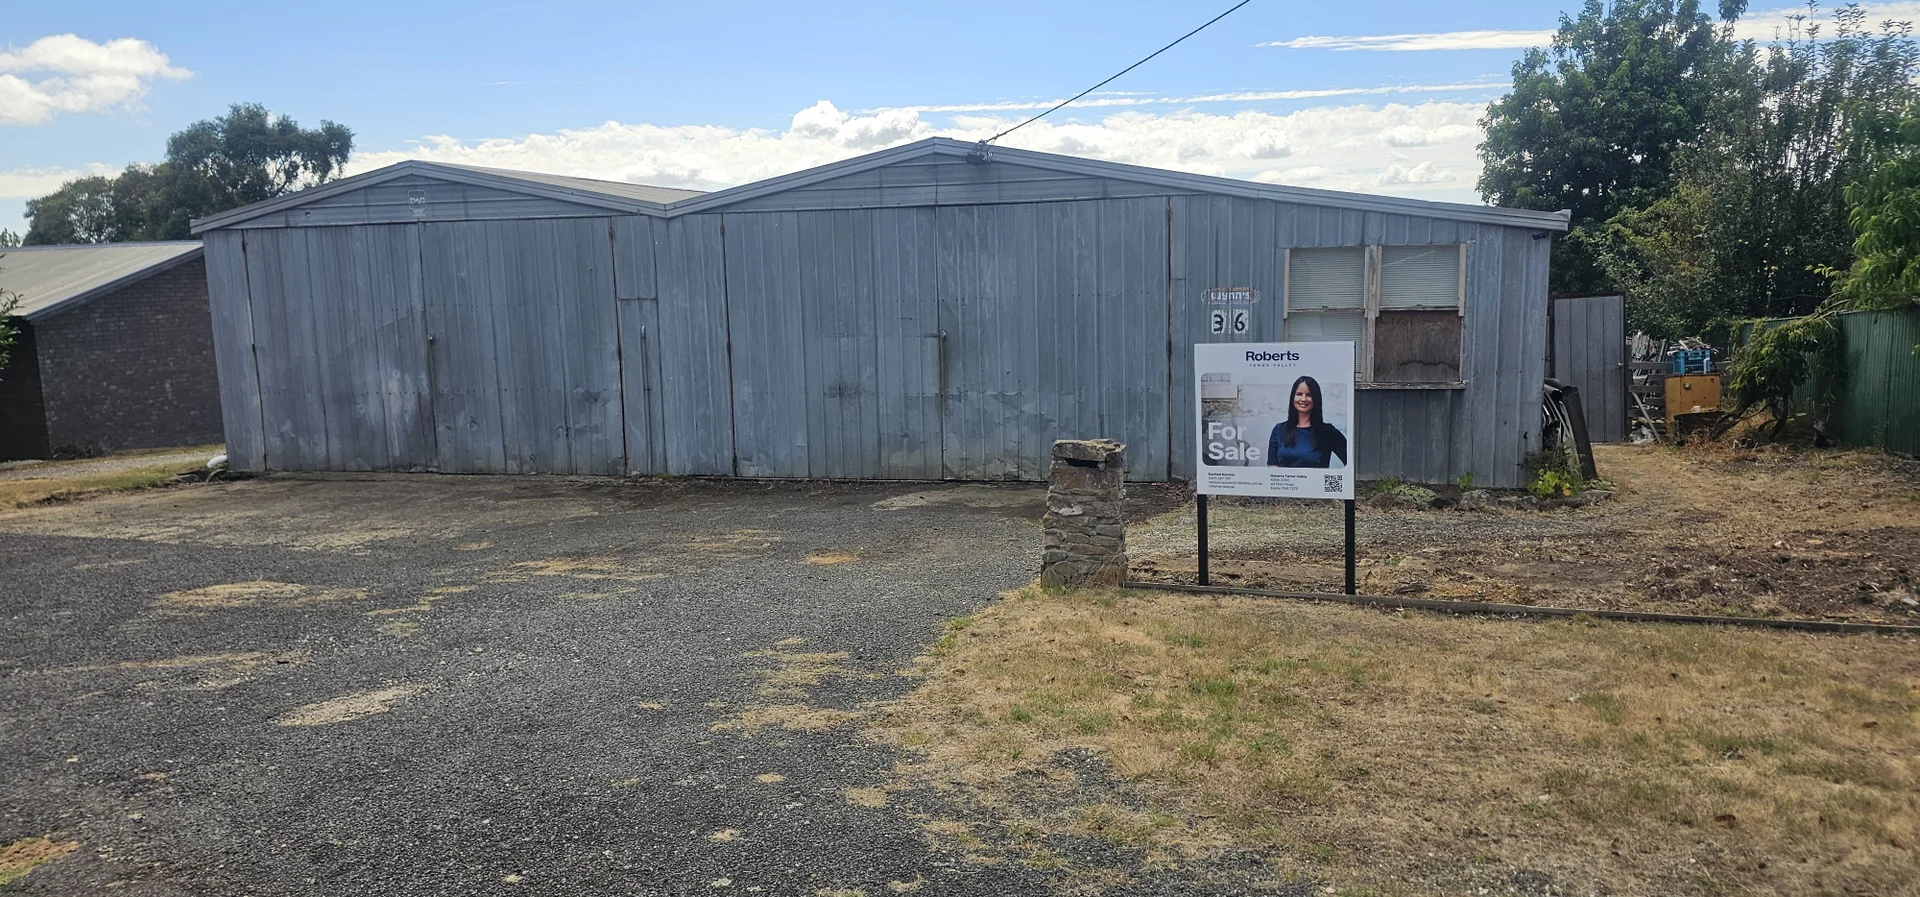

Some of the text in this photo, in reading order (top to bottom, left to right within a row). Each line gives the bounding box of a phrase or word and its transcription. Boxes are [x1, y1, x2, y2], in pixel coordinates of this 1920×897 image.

[1213, 312, 1246, 332] 36
[1245, 350, 1300, 362] Roberts
[1208, 422, 1247, 441] For
[1208, 442, 1261, 462] Sale
